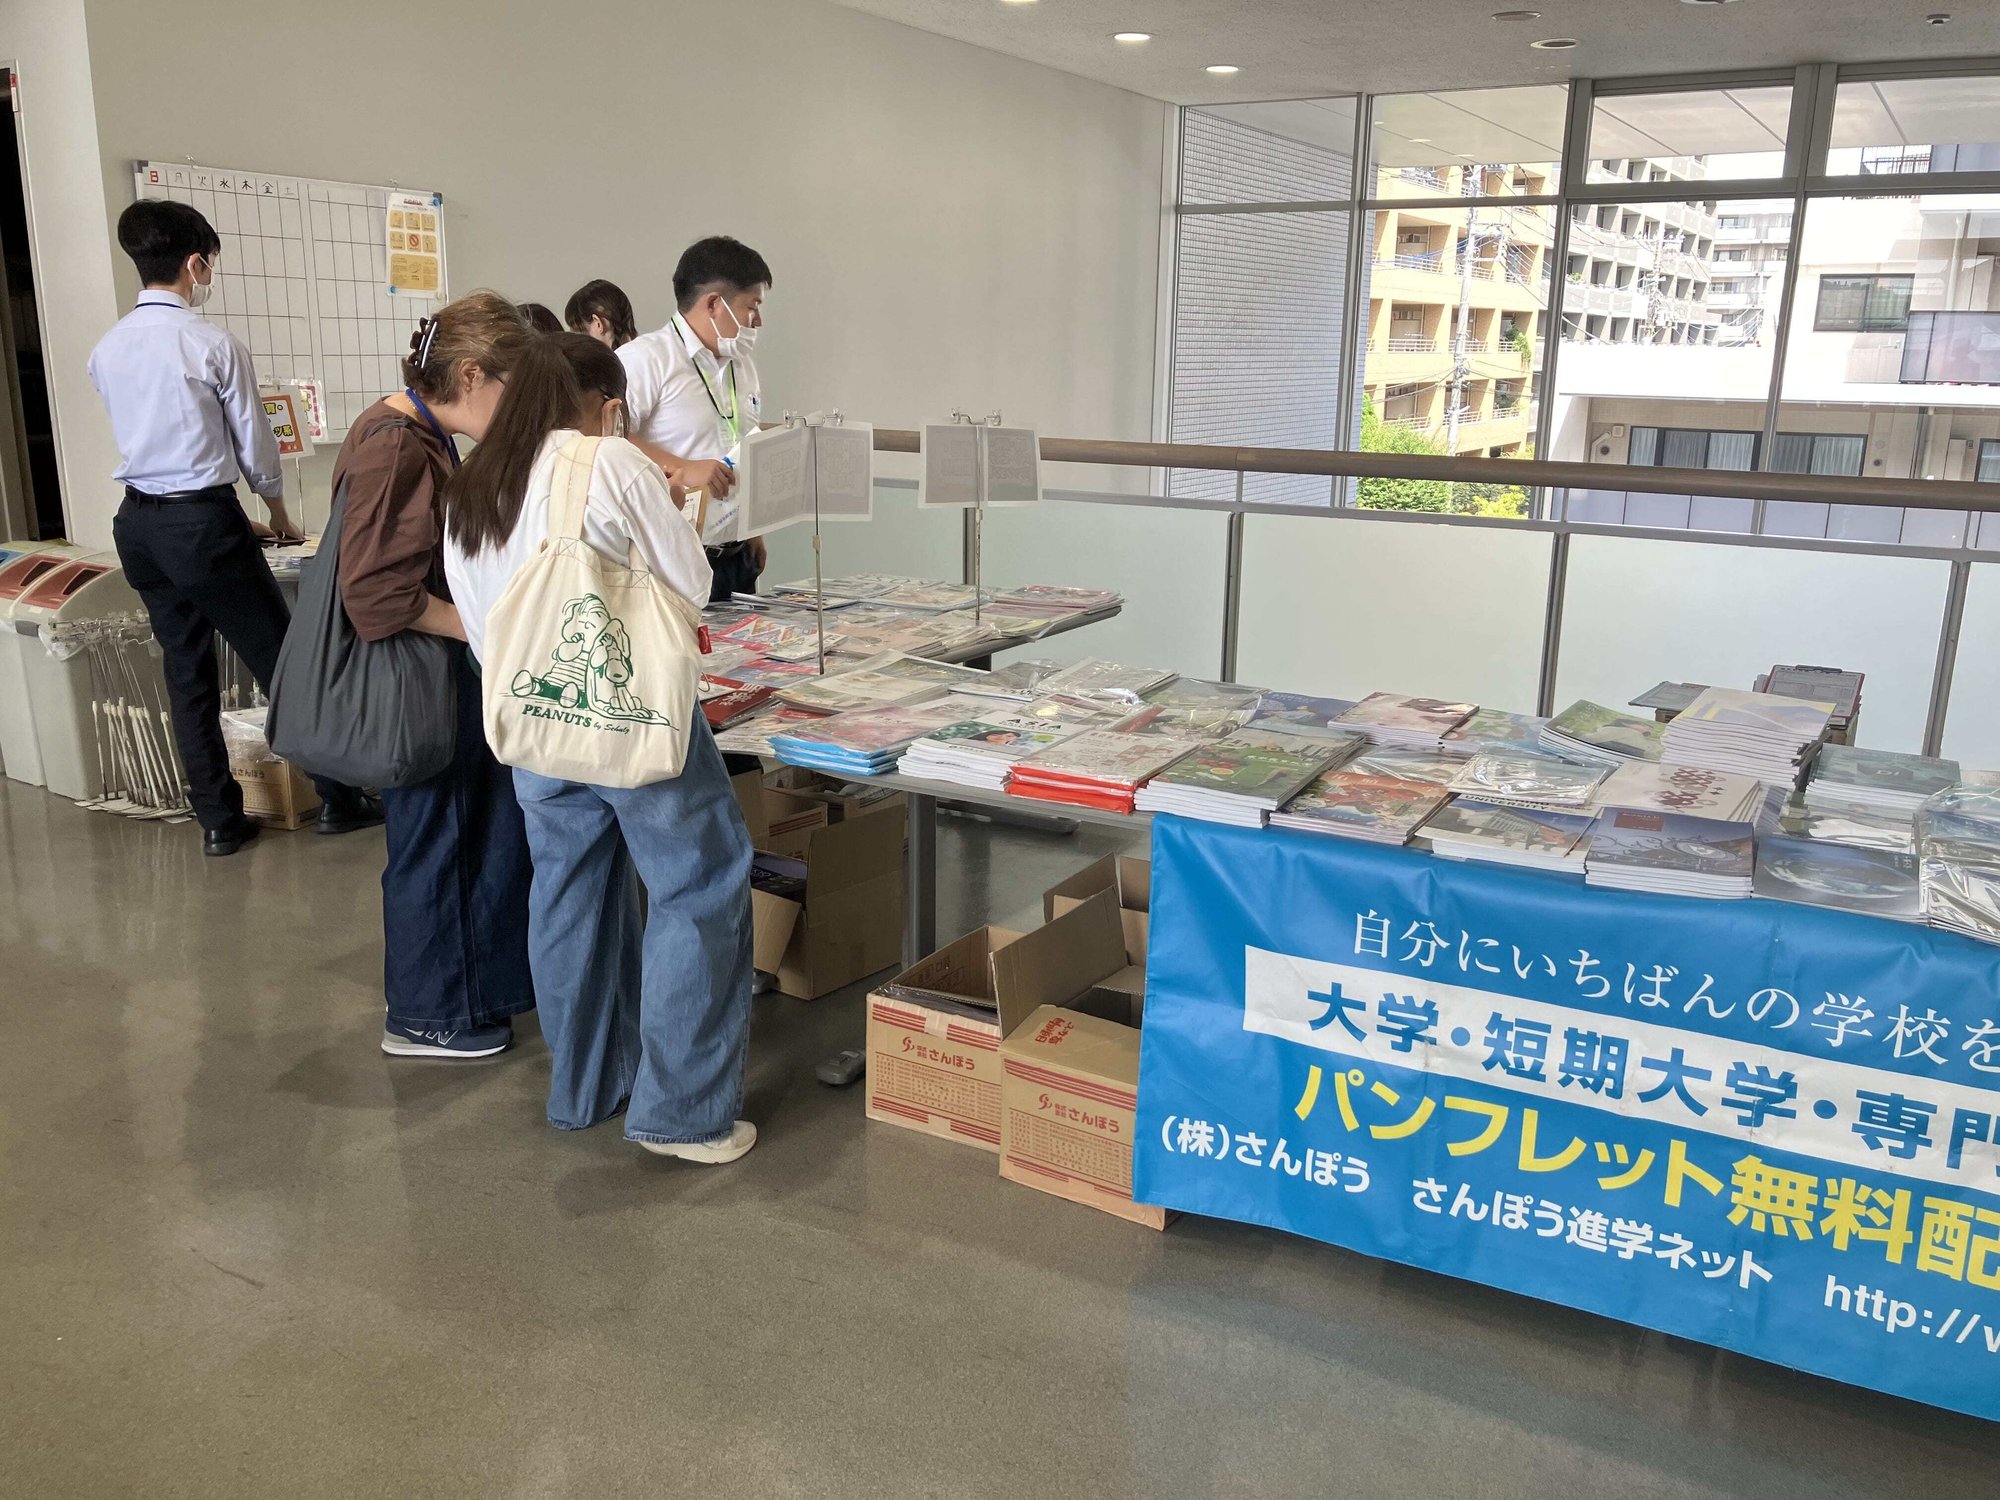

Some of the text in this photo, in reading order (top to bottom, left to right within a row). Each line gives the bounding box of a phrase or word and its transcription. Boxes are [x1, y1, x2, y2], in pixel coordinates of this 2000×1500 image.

[220, 178, 231, 189] 水
[242, 180, 253, 190] 木
[262, 182, 273, 194] 金
[522, 704, 592, 728] PEANUTS
[594, 722, 602, 730] by
[1465, 795, 1548, 810] UNIVERSITY
[1354, 909, 2000, 1073] 自分にいちばんの学校を
[1307, 981, 2000, 1178] 大学・短期大学・専門
[1294, 1064, 2000, 1291] パンフレット無料配
[1412, 1177, 1772, 1290] さんぽう進学ネット
